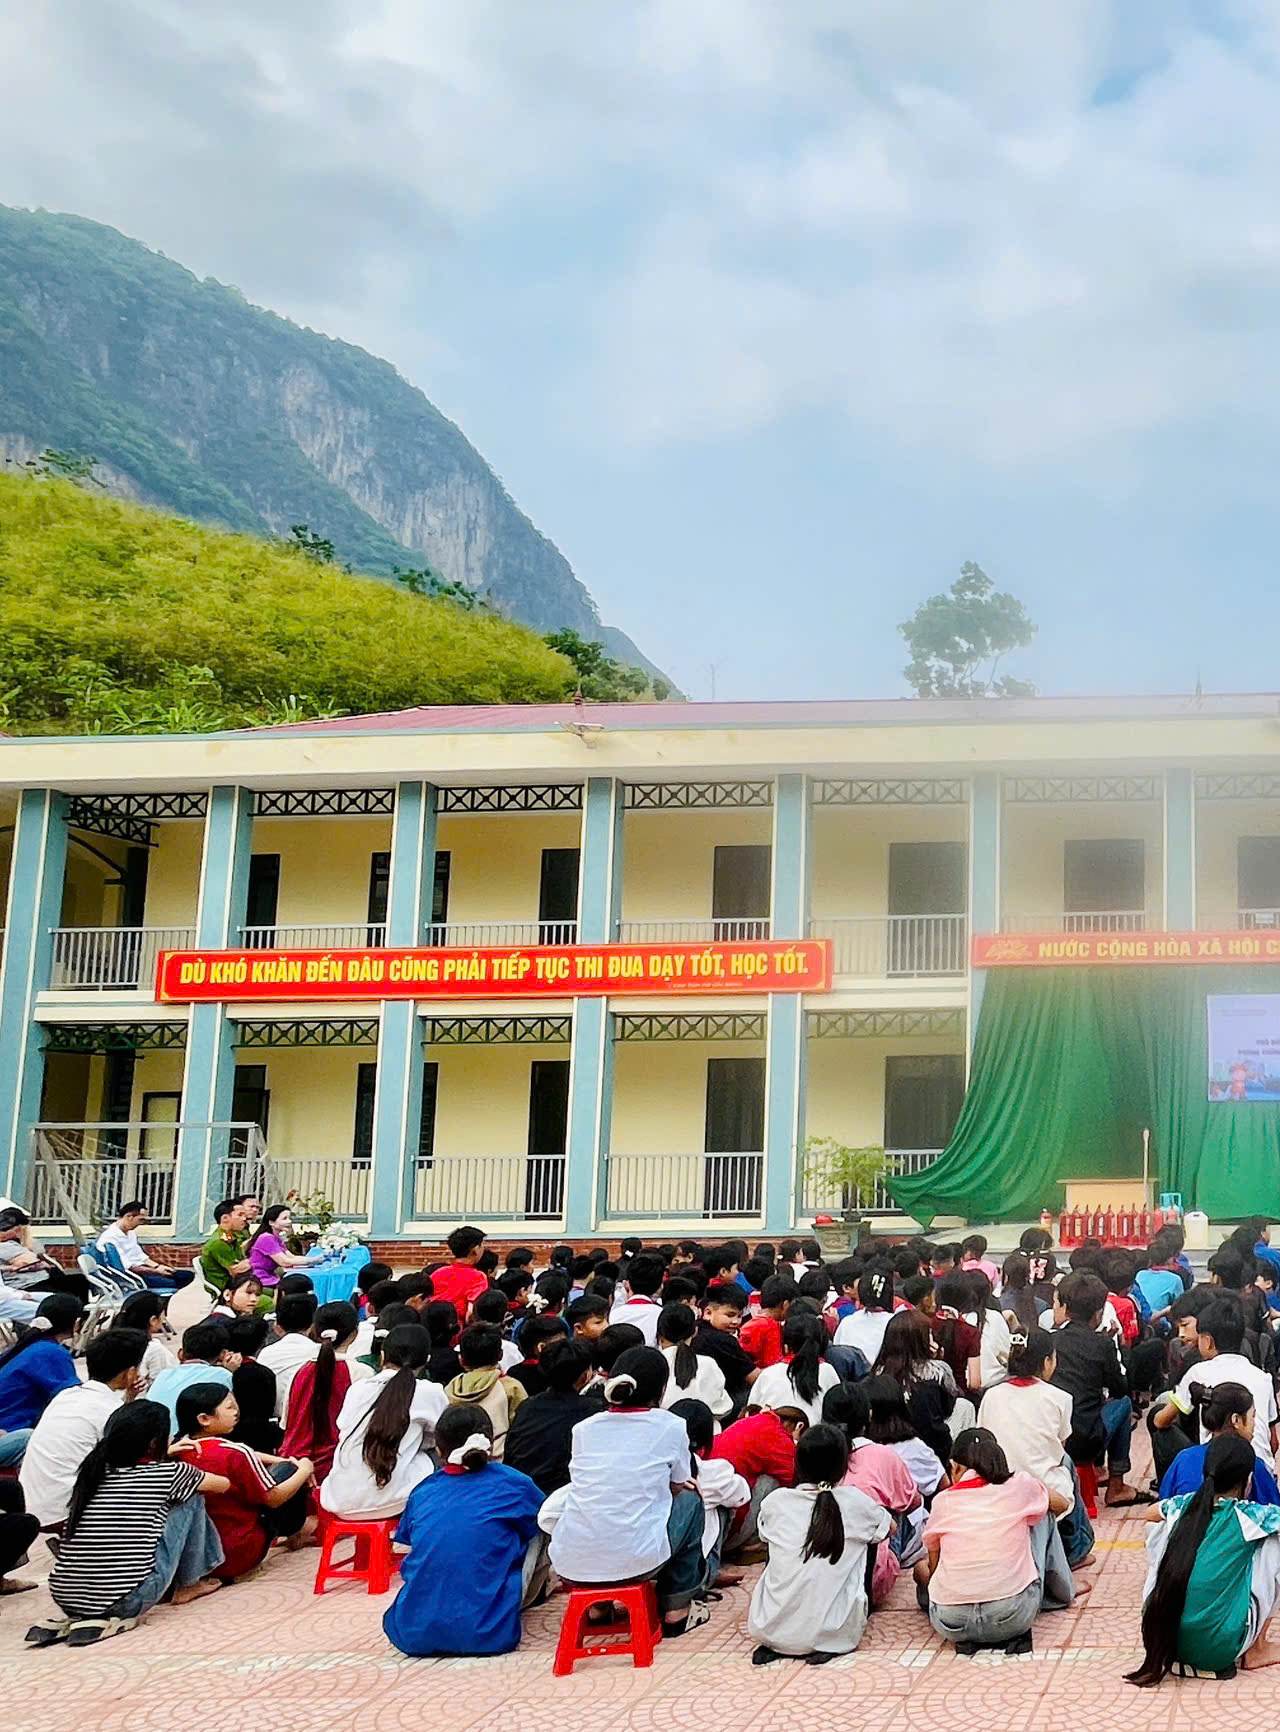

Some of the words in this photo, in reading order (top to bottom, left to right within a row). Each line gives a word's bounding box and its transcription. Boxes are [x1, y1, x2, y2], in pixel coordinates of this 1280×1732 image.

[1039, 940, 1089, 957] NƯỚC
[1097, 938, 1148, 959] CỘNG
[1154, 937, 1191, 956] HÒA
[1229, 937, 1260, 955] HỘI
[180, 958, 205, 984] DÙ
[209, 957, 247, 983] KHÓ
[251, 957, 302, 982] KHĂN
[305, 954, 343, 982] ĐẾN
[347, 956, 384, 982] ĐÂU
[389, 957, 438, 981] CŨNG
[443, 952, 486, 980] PHẢI
[491, 952, 530, 980] TIẾP
[536, 957, 570, 983] TỤC
[575, 957, 603, 979] THI
[607, 955, 644, 978] ĐUA
[648, 953, 685, 981] DẠY
[690, 946, 726, 977] TỐT,
[730, 952, 768, 979] HỌC
